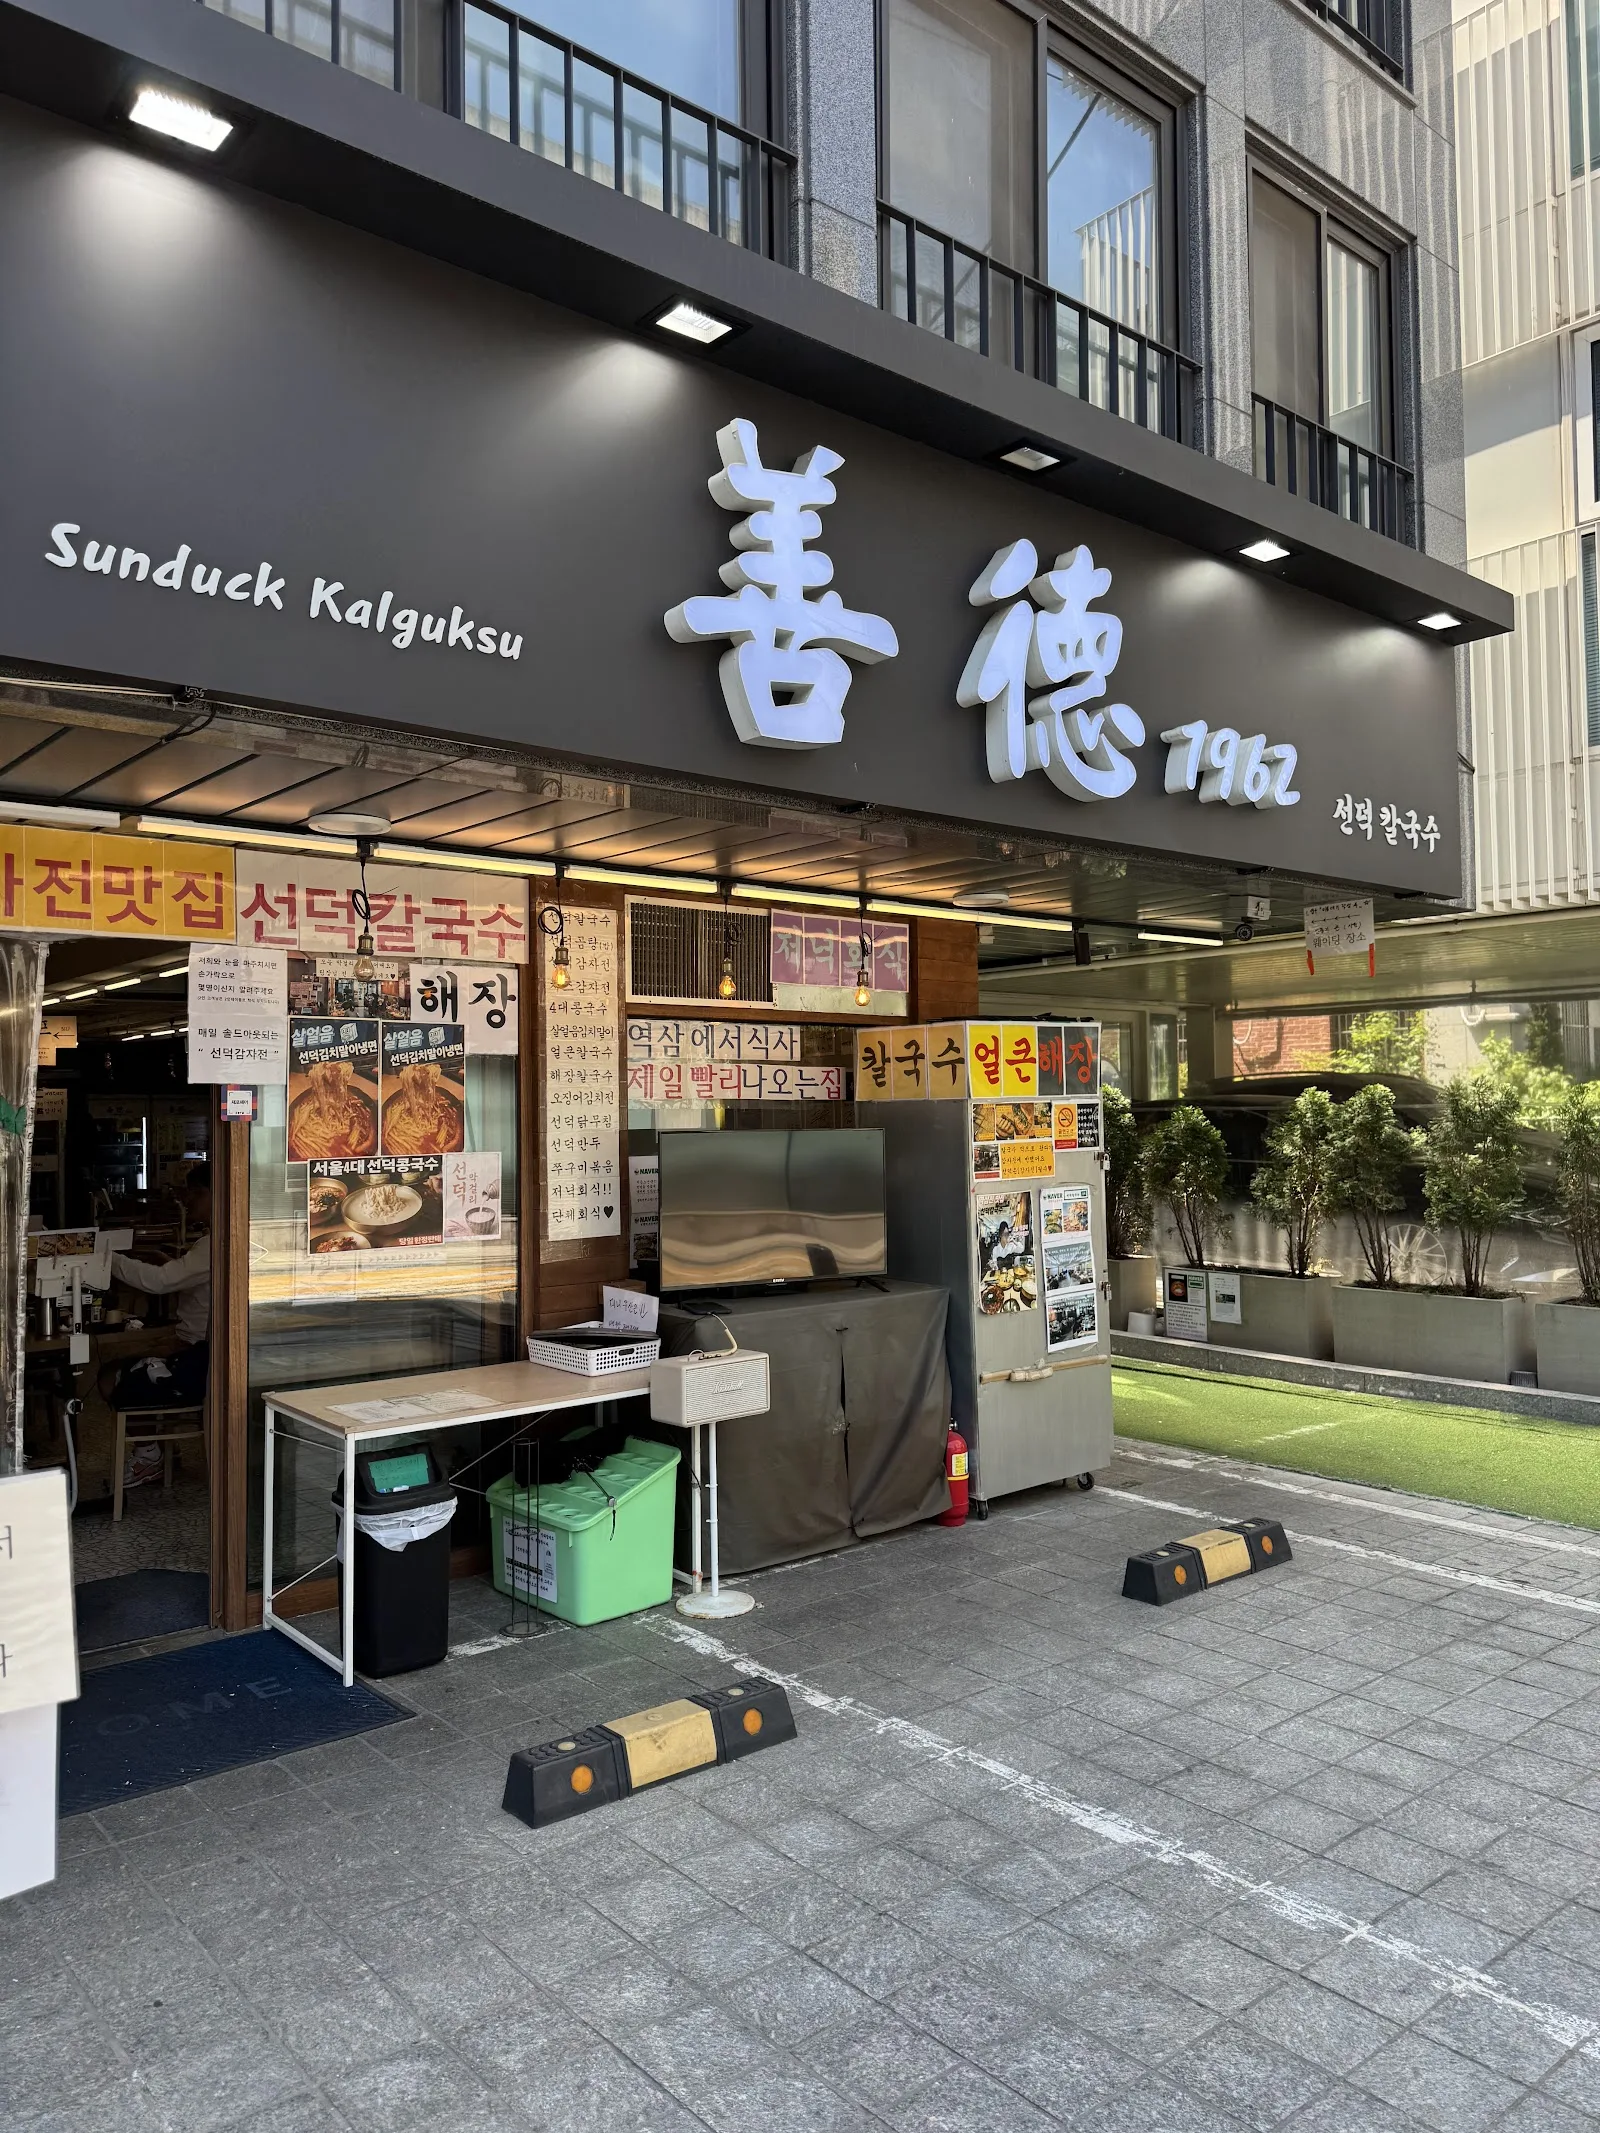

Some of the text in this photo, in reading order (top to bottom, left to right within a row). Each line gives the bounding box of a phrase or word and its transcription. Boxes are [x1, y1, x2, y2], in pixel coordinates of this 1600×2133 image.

[44, 521, 524, 661] Sunduck Kalguksu
[1160, 719, 1301, 810] 1962
[1332, 793, 1442, 853] 선덕 칼국수
[239, 881, 527, 958] 선덕칼국수
[1312, 932, 1367, 948] 웨이팅 장소
[198, 957, 221, 966] 저희와
[198, 970, 236, 980] 손가락으로
[239, 985, 274, 995] 알려주세요
[416, 970, 517, 1029] 해장
[198, 1027, 279, 1040] 매일 솔드아웃되는
[290, 1023, 336, 1049] 살얼음
[383, 1027, 425, 1051] 살얼음
[550, 1024, 614, 1039] 살얼음김치말이
[297, 1040, 378, 1065] 선덕김치말이냉면
[389, 1043, 464, 1067] 선덕김치말이냉면
[550, 1045, 613, 1060] 얼큰칼국수
[861, 1037, 966, 1089] 칼국수
[550, 1068, 613, 1084] 해장칼국수
[550, 1090, 614, 1106] 오징어김치전
[550, 1114, 612, 1130] 선덕닭무침
[551, 1136, 601, 1153] 선덕만두
[312, 1156, 439, 1177] 서울4대 선덕콩국수
[452, 1161, 467, 1207] 선덕
[640, 1215, 659, 1223] NAVER
